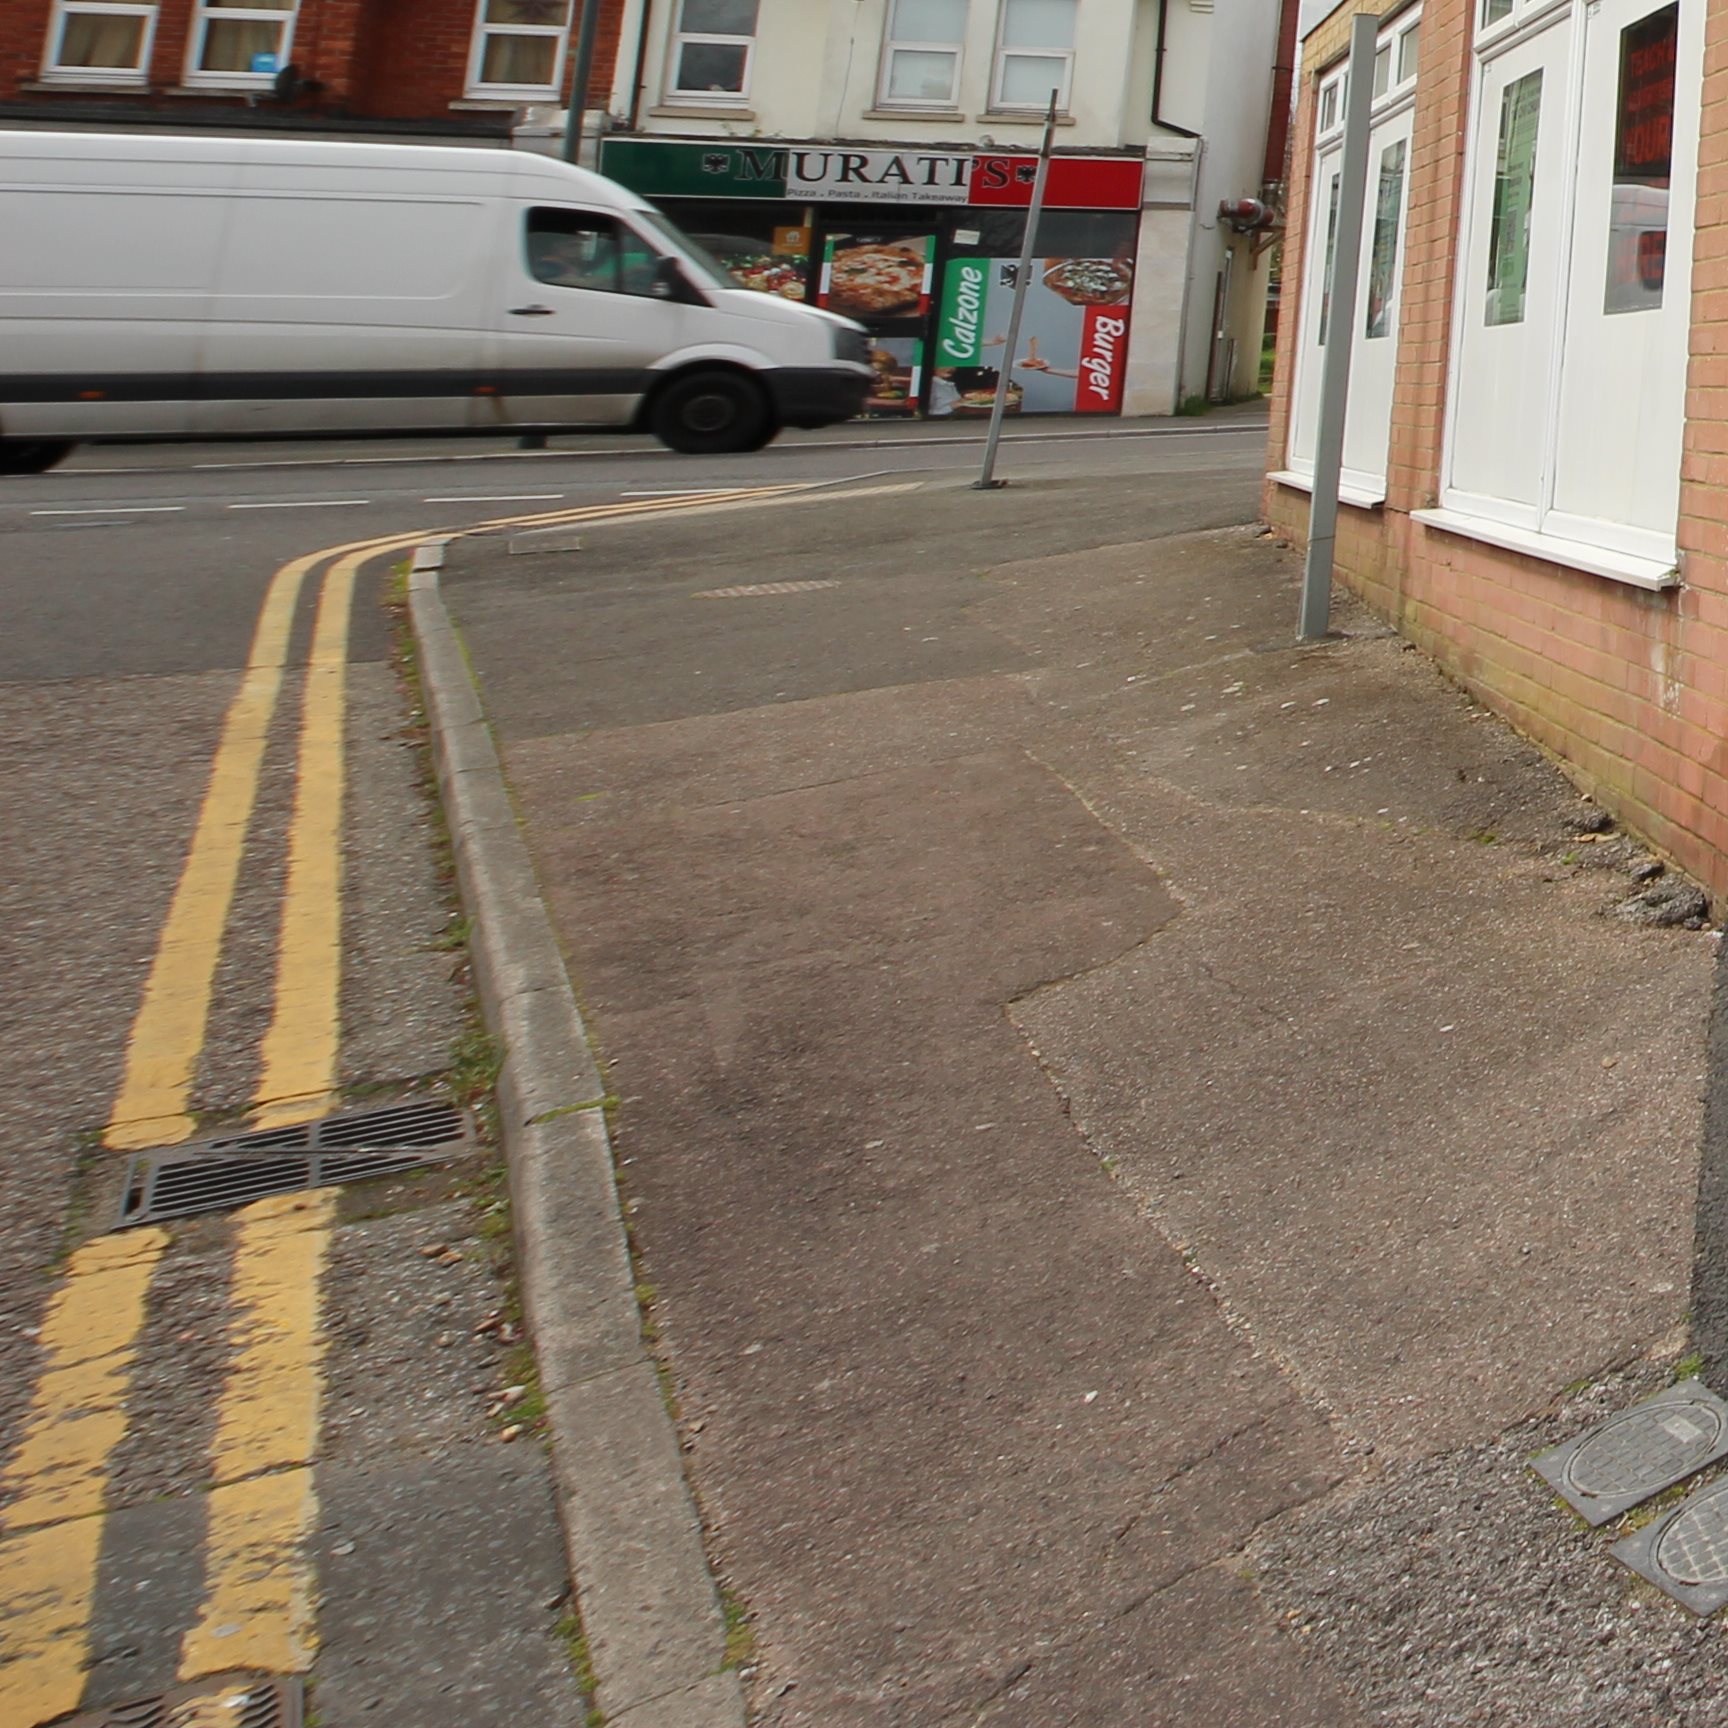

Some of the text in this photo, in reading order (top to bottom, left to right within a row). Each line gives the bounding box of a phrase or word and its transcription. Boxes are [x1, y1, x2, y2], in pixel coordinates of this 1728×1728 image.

[735, 148, 1010, 189] MURATI'S
[786, 188, 968, 203] Pizza Pasta Italian Takeaway
[942, 266, 983, 359] Calzone
[1081, 315, 1125, 401] Burger
